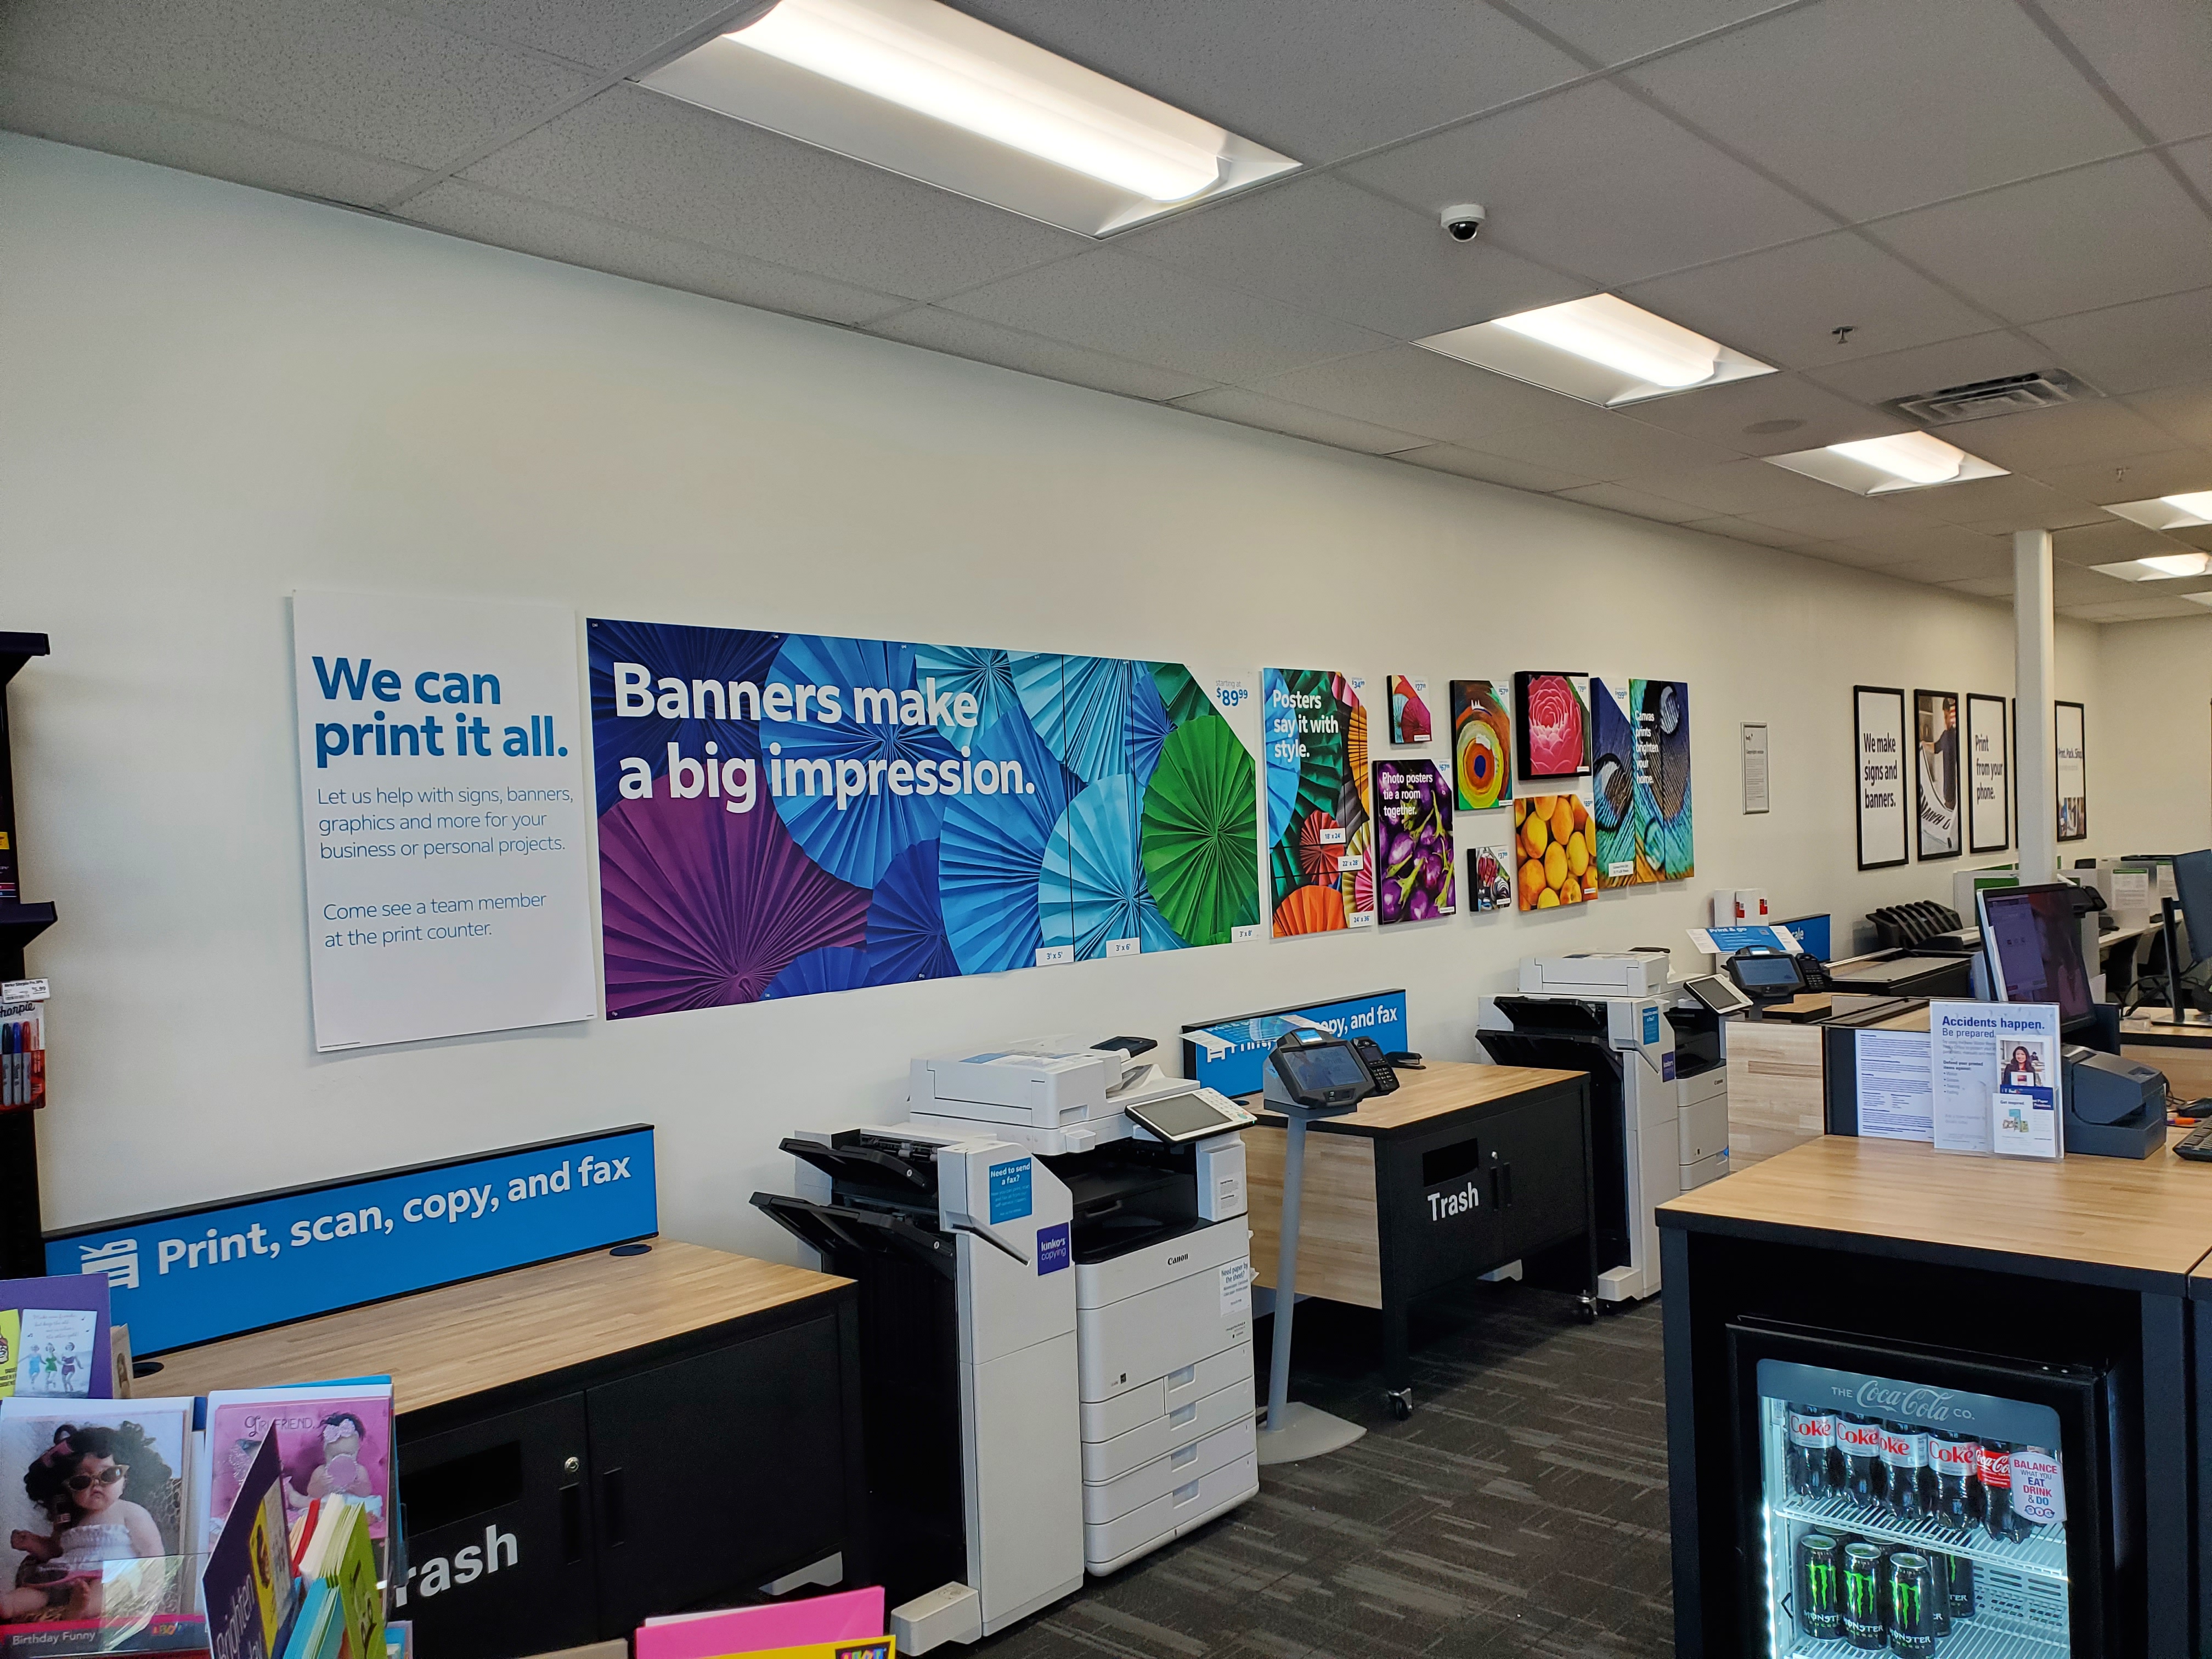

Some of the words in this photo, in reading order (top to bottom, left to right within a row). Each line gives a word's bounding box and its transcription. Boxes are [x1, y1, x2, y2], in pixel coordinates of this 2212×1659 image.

[312, 656, 401, 702] We
[415, 672, 500, 704] can
[1216, 680, 1235, 689] starting
[613, 661, 842, 723] Banners
[855, 677, 978, 727] make
[1273, 690, 1322, 709] Posters
[1635, 710, 1655, 721] Canvas
[1274, 721, 1296, 737] say
[1298, 715, 1309, 733] it
[1311, 715, 1339, 733] with
[1635, 726, 1651, 738] prints
[315, 710, 443, 768] print
[455, 712, 491, 757] it
[503, 715, 568, 757] all.
[1636, 742, 1658, 755] brighten
[1864, 732, 1875, 753] We
[1877, 732, 1896, 753] make
[1975, 733, 1989, 752] Print
[1274, 740, 1310, 762] style.
[1637, 760, 1649, 771] your
[1865, 759, 1883, 786] signs
[1885, 759, 1897, 780] and
[1977, 758, 1990, 776] from
[1991, 763, 2002, 780] your
[618, 755, 653, 799] a
[667, 741, 757, 814] big
[769, 744, 1035, 810] impression.
[1382, 772, 1404, 784] Photo
[1406, 774, 1433, 786] posters
[1637, 773, 1654, 784] home.
[318, 788, 347, 805] Let
[352, 791, 371, 805] us
[376, 787, 413, 811] help
[418, 787, 453, 804] with
[458, 787, 503, 810] signs,
[507, 786, 573, 804] banners,
[1383, 789, 1393, 800] tie
[1402, 790, 1421, 799] room
[1865, 788, 1896, 809] banners.
[1977, 782, 1995, 805] phone.
[1384, 804, 1417, 818] together.
[319, 814, 394, 836] graphics
[400, 813, 432, 830] and
[437, 816, 481, 829] more
[485, 812, 507, 828] for
[512, 814, 546, 832] your
[320, 840, 396, 859] business
[401, 844, 419, 856] or
[424, 838, 494, 860] personal
[500, 836, 565, 857] projects.
[324, 903, 377, 920] Come
[381, 904, 411, 917] see
[416, 904, 426, 915] a
[431, 898, 473, 914] team
[478, 893, 546, 911] member
[325, 932, 343, 948] at
[348, 929, 377, 946] the
[382, 925, 422, 947] print
[427, 922, 492, 940] counter.
[1792, 927, 1804, 940] cale
[0, 1002, 35, 1017] harpie
[1351, 1008, 1374, 1031] and
[1377, 1005, 1398, 1024] fax
[1942, 1016, 1997, 1028] Accidents
[2001, 1018, 2045, 1031] happen.
[1943, 1028, 1954, 1036] Be
[991, 1167, 1007, 1178] Need
[1016, 1162, 1030, 1172] send
[1007, 1175, 1020, 1184] fax?
[1427, 1182, 1479, 1221] Trash
[158, 1221, 280, 1275] Print,
[290, 1204, 394, 1248] scan,
[402, 1180, 499, 1223] copy,
[507, 1159, 571, 1202] and
[578, 1154, 631, 1188] fax
[1041, 1238, 1066, 1251] kinko's
[1041, 1248, 1066, 1261] copying
[1167, 1254, 1188, 1265] Canon
[1221, 1267, 1231, 1277] Need
[1232, 1264, 1243, 1274] paper
[1233, 1271, 1245, 1282] sheet?
[1831, 1387, 1853, 1398] THE
[1857, 1380, 1955, 1421] Coca-Cola
[1953, 1408, 1975, 1420] CO.
[1791, 1415, 1831, 1436] Coke
[1837, 1423, 1878, 1445] Coke
[1880, 1436, 1910, 1455] oke
[1929, 1441, 1973, 1463] Coke
[2014, 1459, 2058, 1474] BALANCE
[2023, 1485, 2052, 1497] DRINK
[2028, 1495, 2034, 1503] &
[2036, 1497, 2049, 1505] DO
[377, 1524, 518, 1607] rash
[1843, 1616, 1883, 1633] MONSTER
[13, 1634, 59, 1645] Birthday
[63, 1631, 95, 1643] Funny
[1889, 1627, 1931, 1644] MONSTER
